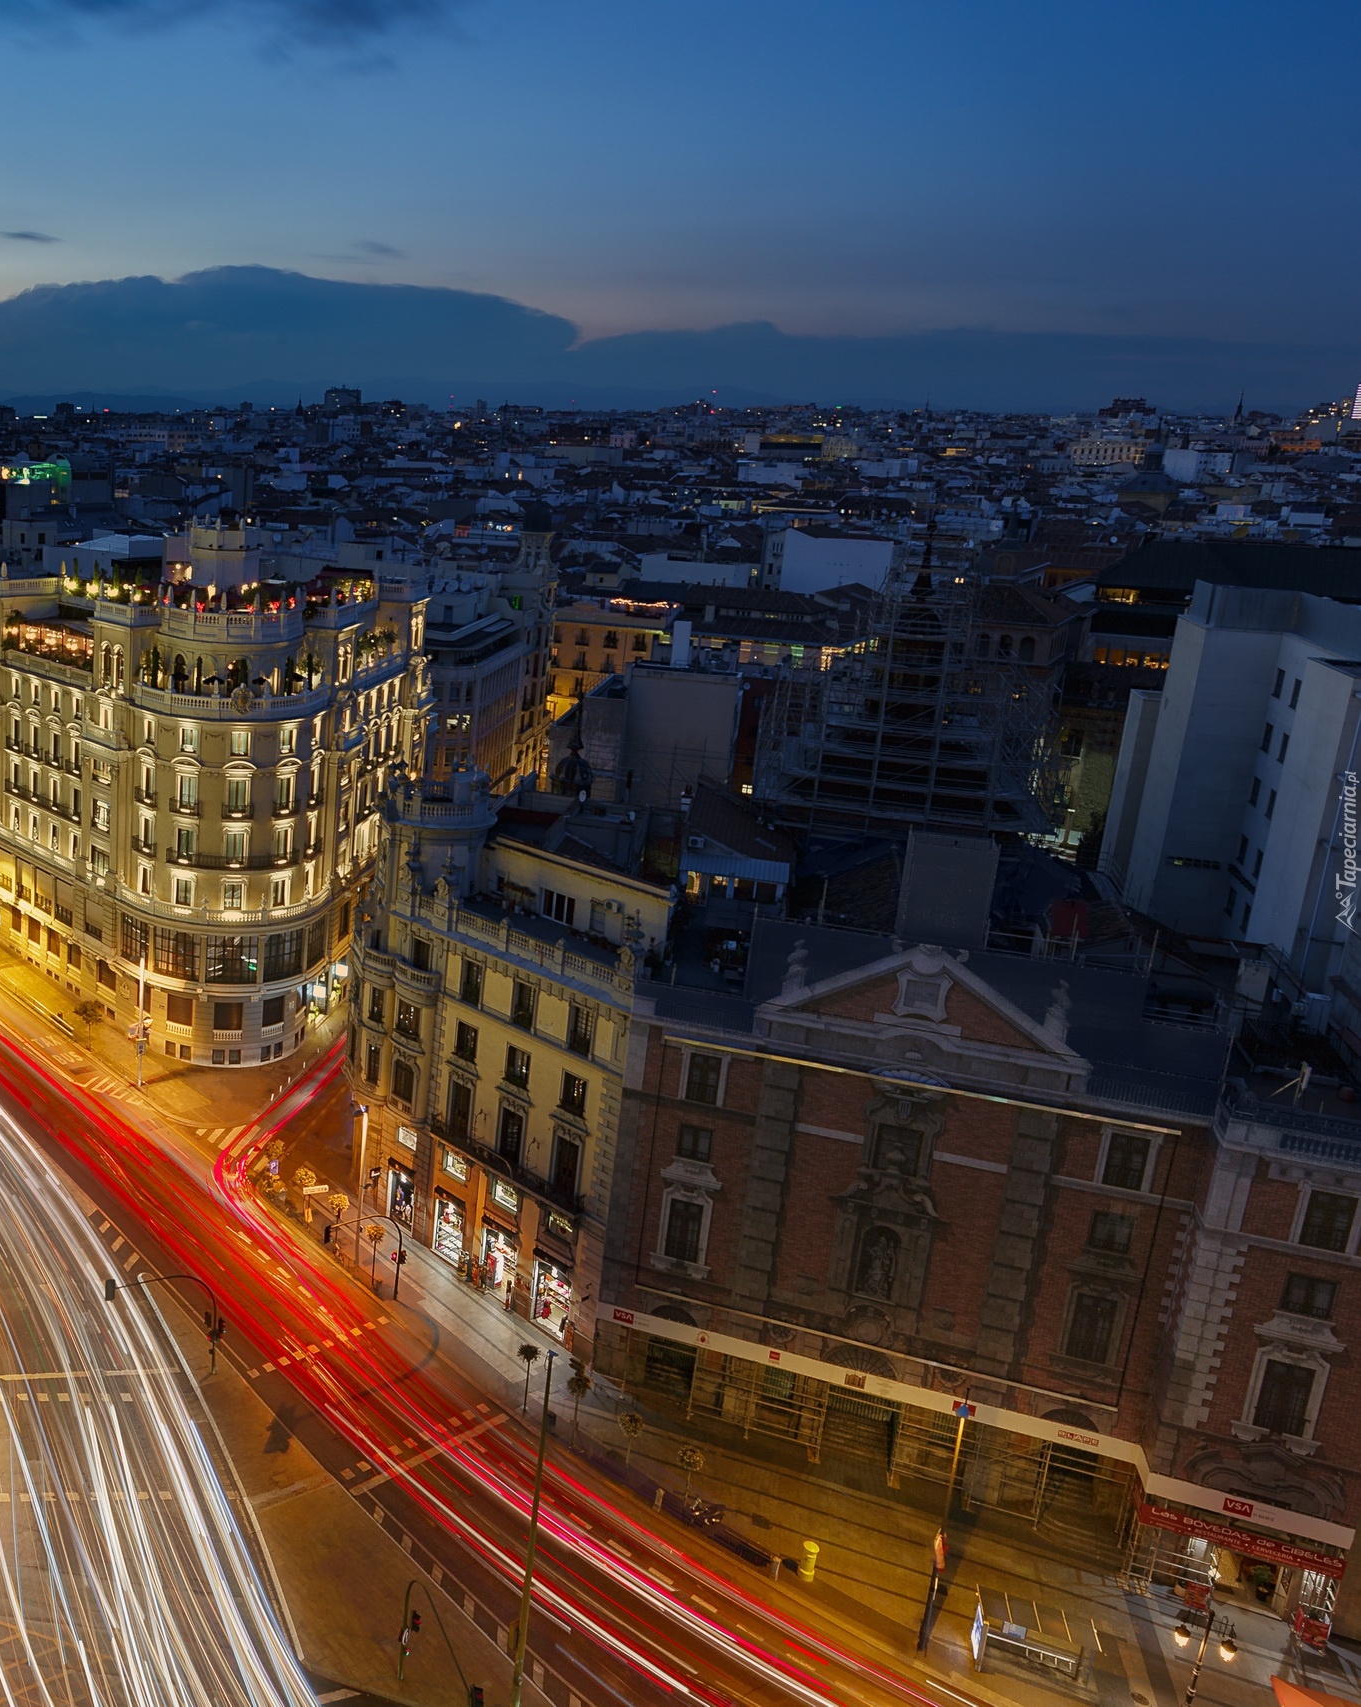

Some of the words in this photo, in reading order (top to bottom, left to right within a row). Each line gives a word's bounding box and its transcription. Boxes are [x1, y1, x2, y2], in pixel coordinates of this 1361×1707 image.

[51, 1051, 83, 1065] BUS
[615, 1310, 633, 1321] VSA
[1225, 1499, 1251, 1513] VSA
[1151, 1507, 1178, 1520] Las
[1256, 1538, 1276, 1548] de
[1281, 1545, 1343, 1568] CIBELES
[1194, 1528, 1241, 1545] RESTAURANTE
[1251, 1545, 1293, 1560] CERVECERÍA
